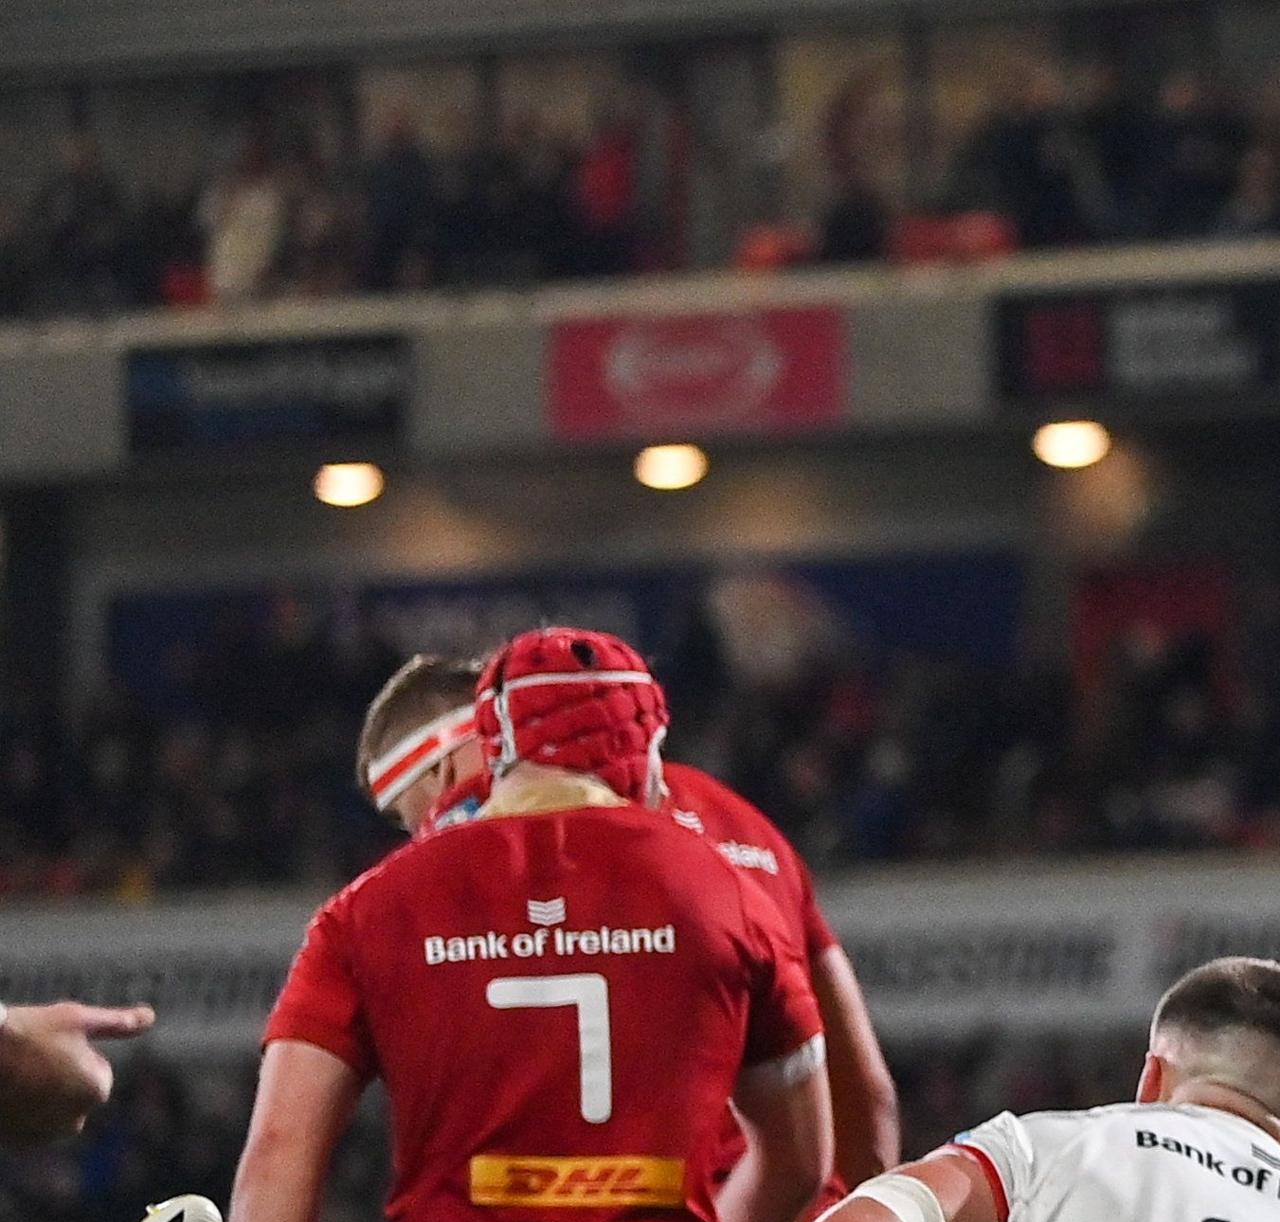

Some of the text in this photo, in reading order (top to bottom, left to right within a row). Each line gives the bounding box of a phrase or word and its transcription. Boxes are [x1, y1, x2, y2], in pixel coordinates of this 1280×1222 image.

[424, 924, 676, 965] Bank of Ireland
[486, 972, 613, 1124] 7
[504, 1166, 651, 1197] DHL
[1136, 1130, 1224, 1177] Bank
[1231, 1166, 1272, 1191] of
